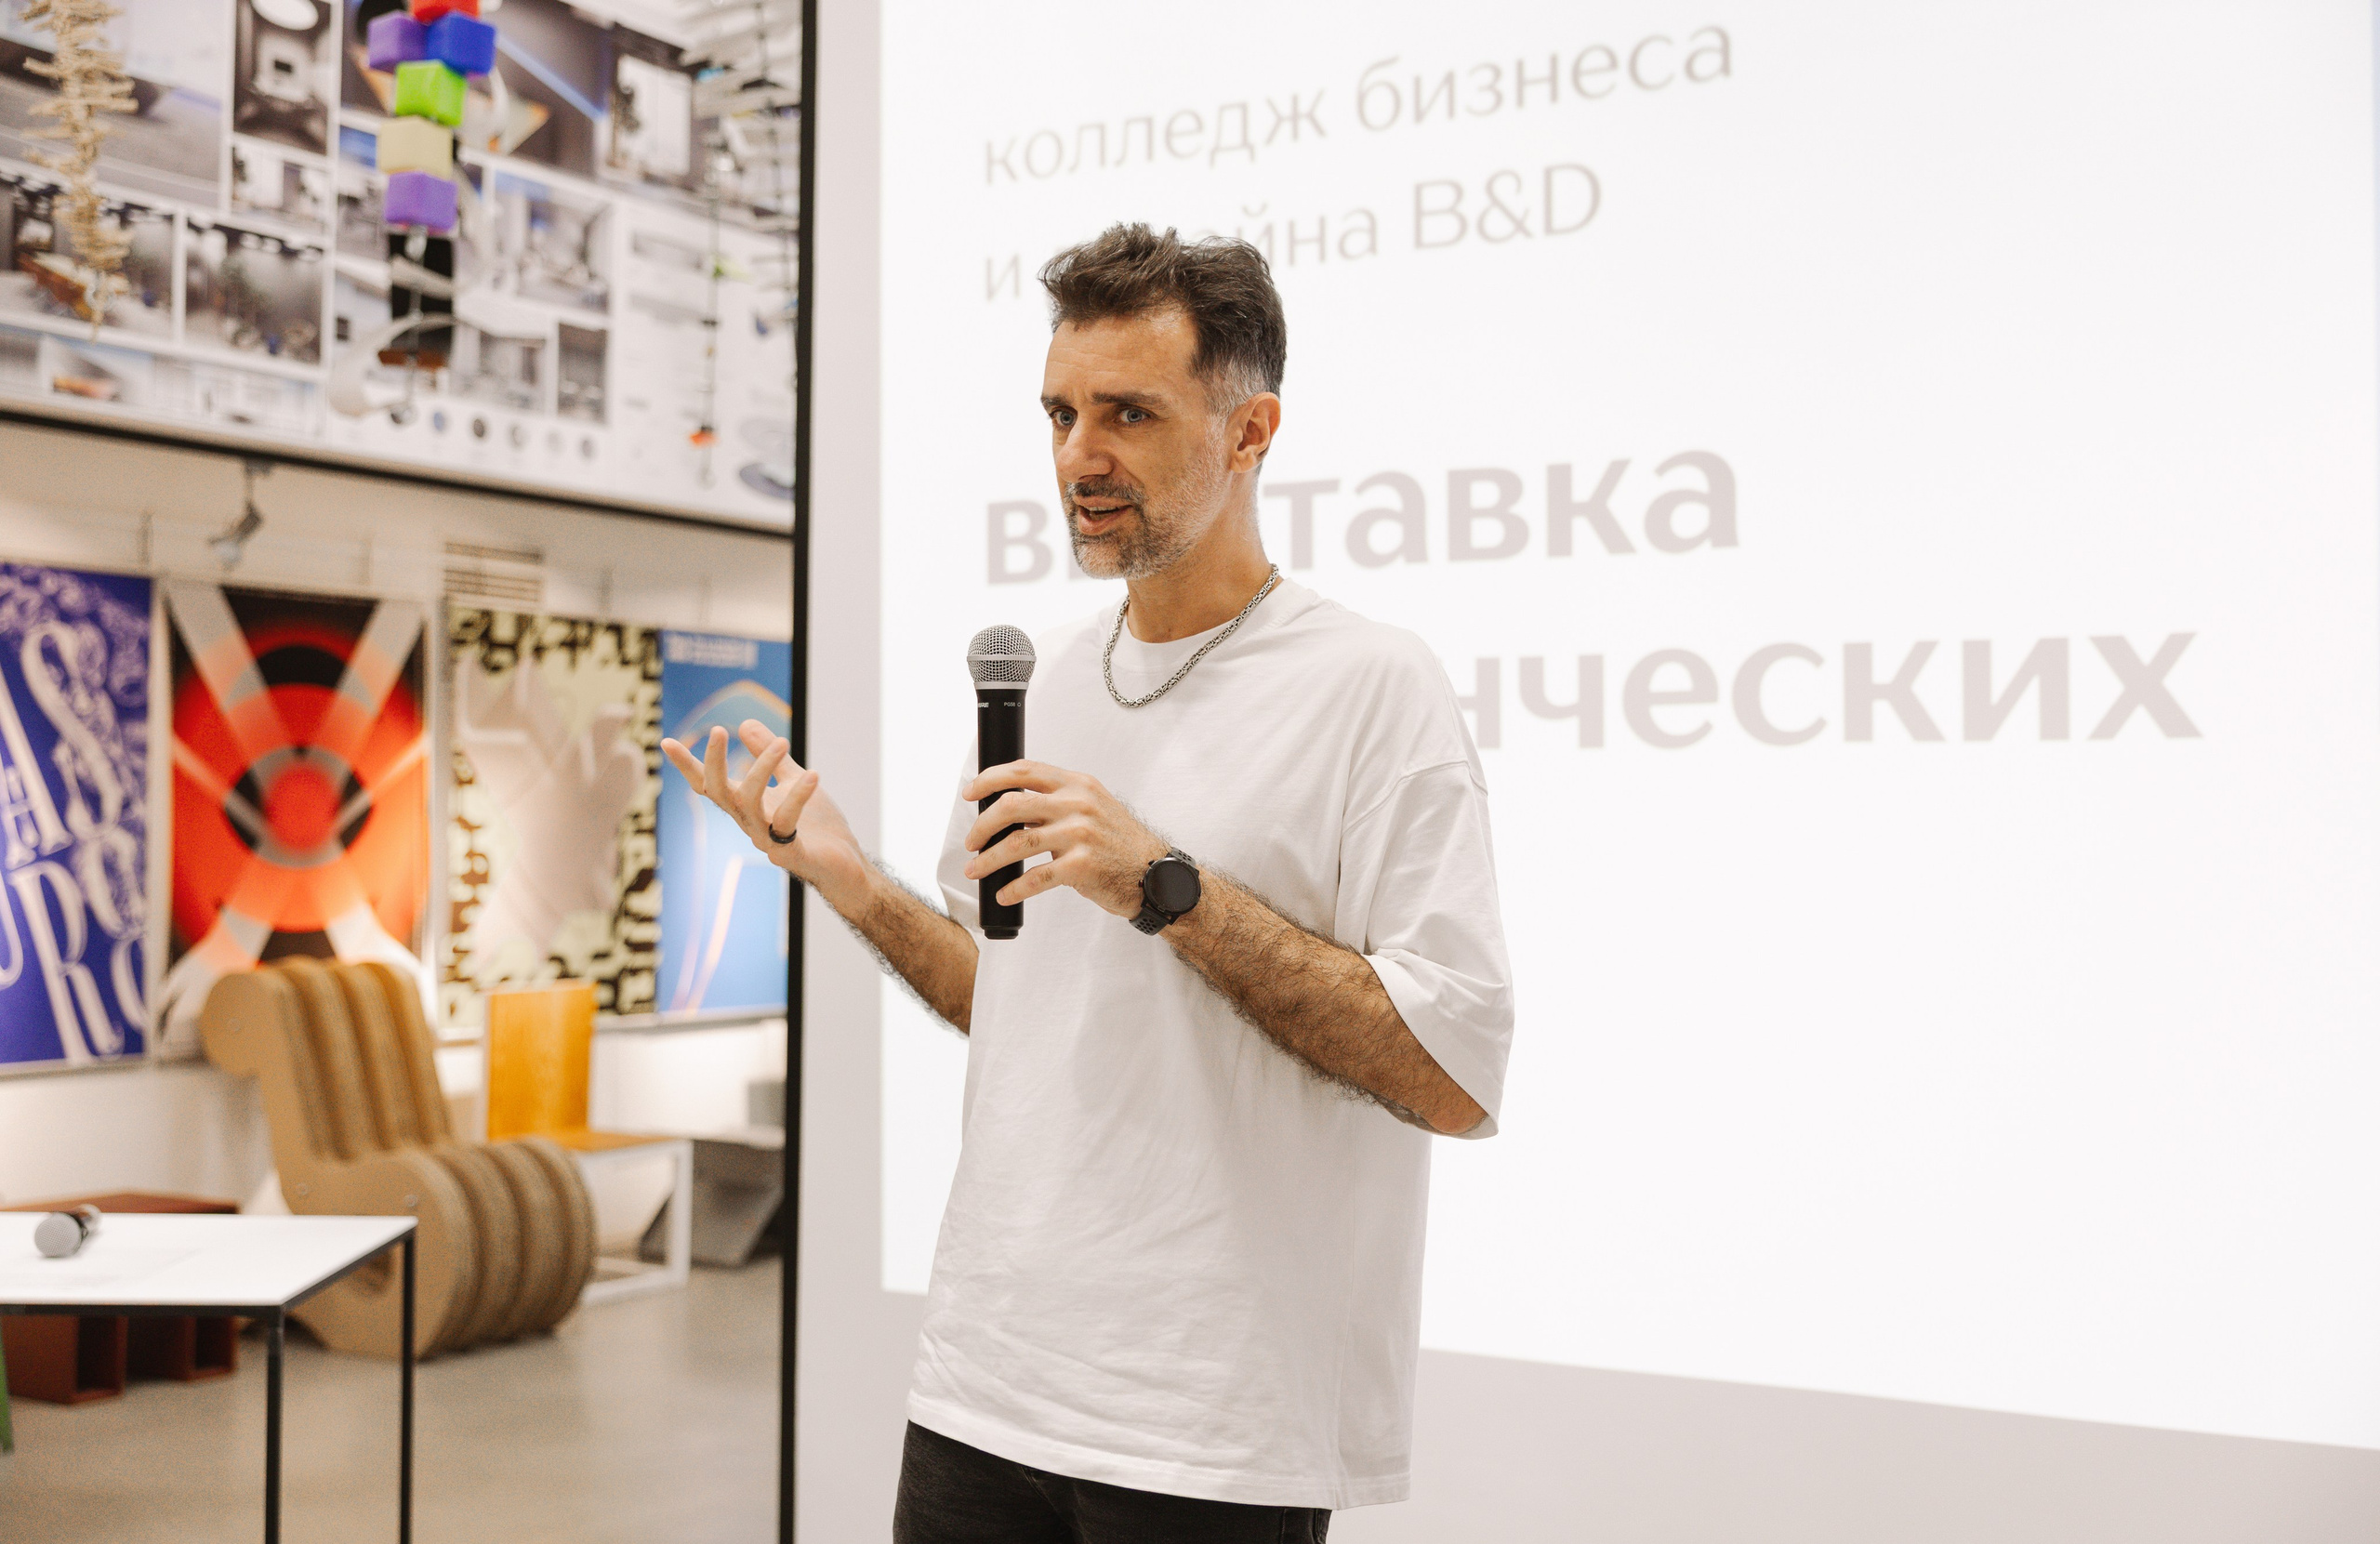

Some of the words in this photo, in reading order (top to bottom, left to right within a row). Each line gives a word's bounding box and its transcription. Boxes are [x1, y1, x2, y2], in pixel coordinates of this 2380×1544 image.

[985, 90, 1327, 185] колледж
[1356, 25, 1734, 131] бизнеса
[985, 254, 1021, 302] и
[1413, 162, 1603, 251] B&D
[987, 450, 1739, 586] втавка
[1458, 632, 2203, 751] нческих
